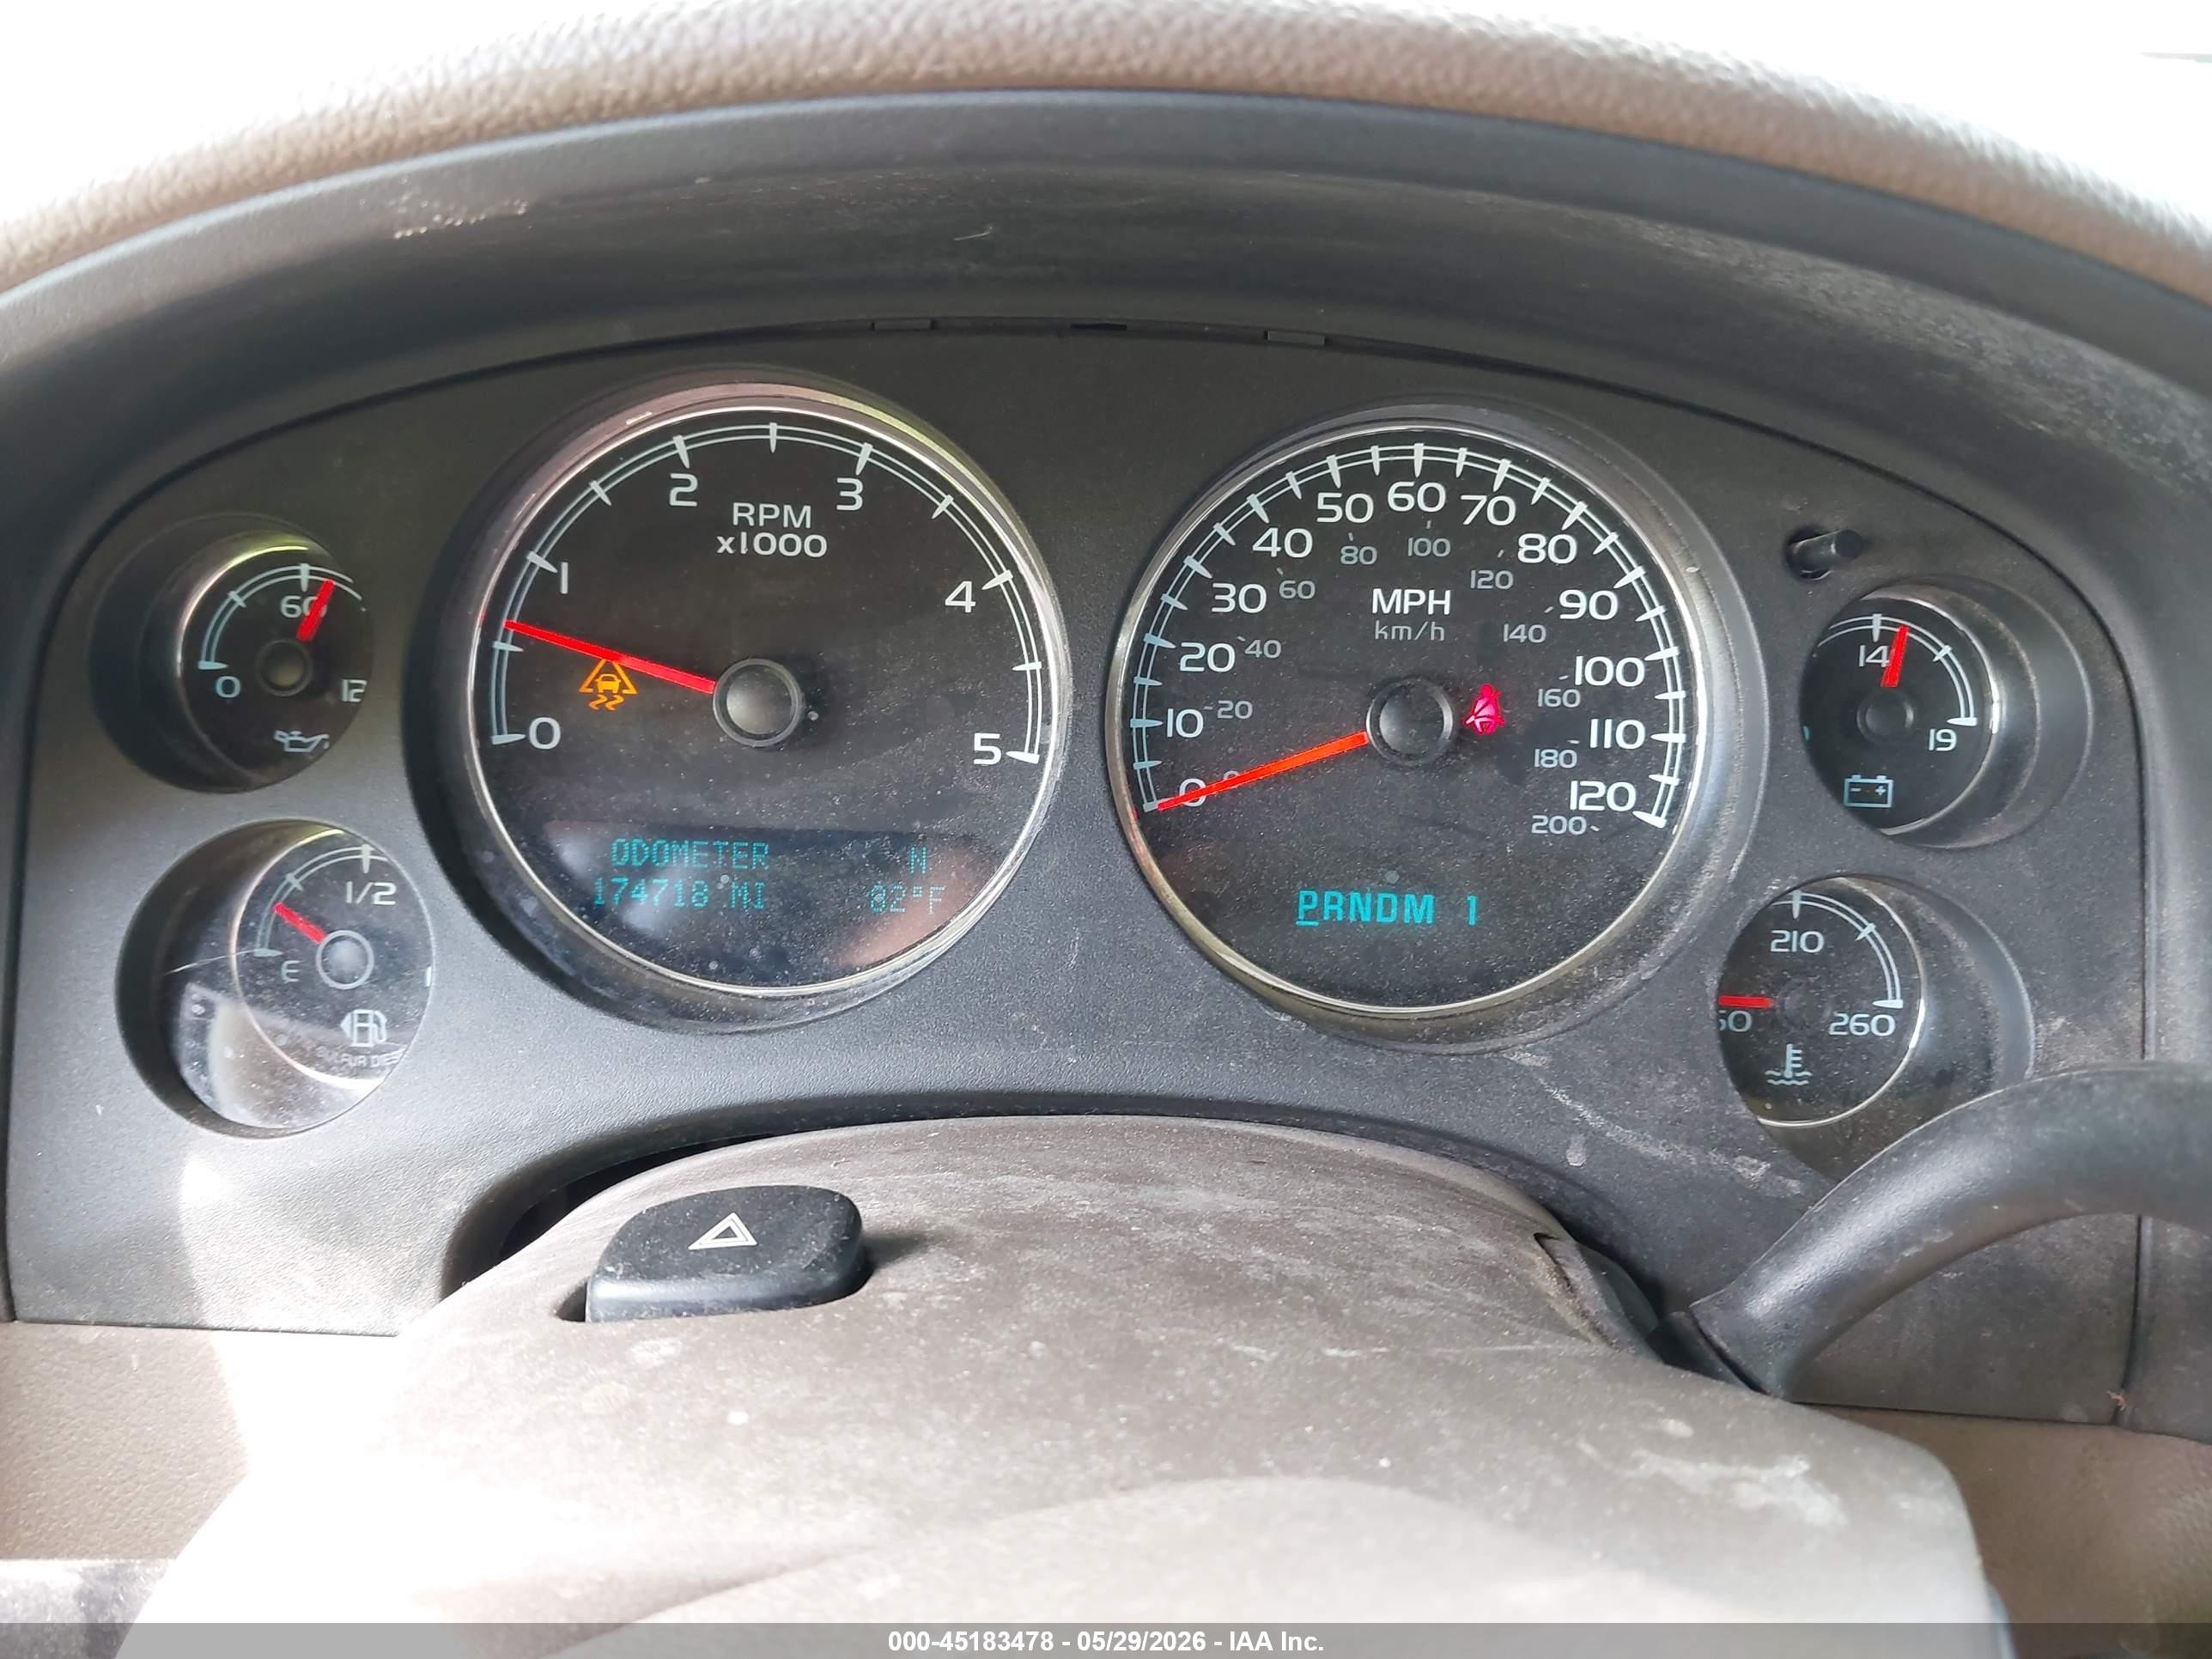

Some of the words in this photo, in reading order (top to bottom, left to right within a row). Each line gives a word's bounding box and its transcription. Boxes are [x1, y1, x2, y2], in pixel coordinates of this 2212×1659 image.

[668, 472, 698, 507] 2
[836, 477, 865, 511] 3
[1387, 481, 1447, 513] 60
[732, 501, 812, 529] RPM
[1316, 492, 1375, 524] 50
[1460, 495, 1516, 526] 70
[716, 532, 829, 558] x1000
[1252, 527, 1313, 558] 40
[1340, 546, 1378, 565] 80
[1407, 537, 1451, 557] 100
[1516, 533, 1577, 564] 80
[559, 562, 569, 595] 1
[1279, 580, 1316, 599] 60
[1469, 569, 1515, 590] 120
[945, 580, 977, 613] 4
[1211, 582, 1267, 614] 30
[1371, 588, 1452, 616] MPH
[1559, 589, 1620, 620] 90
[1375, 620, 1446, 641] km/h
[1503, 623, 1547, 643] 140
[1179, 641, 1237, 672] 20
[1244, 639, 1283, 659] 40
[1858, 645, 1891, 667] 14
[1574, 655, 1646, 687] 100
[215, 676, 241, 699] 0
[1537, 688, 1582, 708] 160
[1166, 708, 1204, 738] 10
[1217, 700, 1254, 720] 20
[528, 717, 562, 750] 0
[1589, 718, 1646, 750] 110
[1928, 728, 1958, 752] 19
[973, 732, 1003, 766] 5
[1534, 748, 1578, 769] 180
[1570, 780, 1638, 811] 120
[1531, 815, 1588, 835] 200
[611, 838, 770, 870] ODOMETER
[910, 845, 928, 874] N
[345, 881, 398, 906] 1/2
[594, 875, 709, 908] 174718
[730, 881, 766, 909] MI
[1770, 930, 1826, 953] 210
[1828, 1012, 1897, 1036] 260
